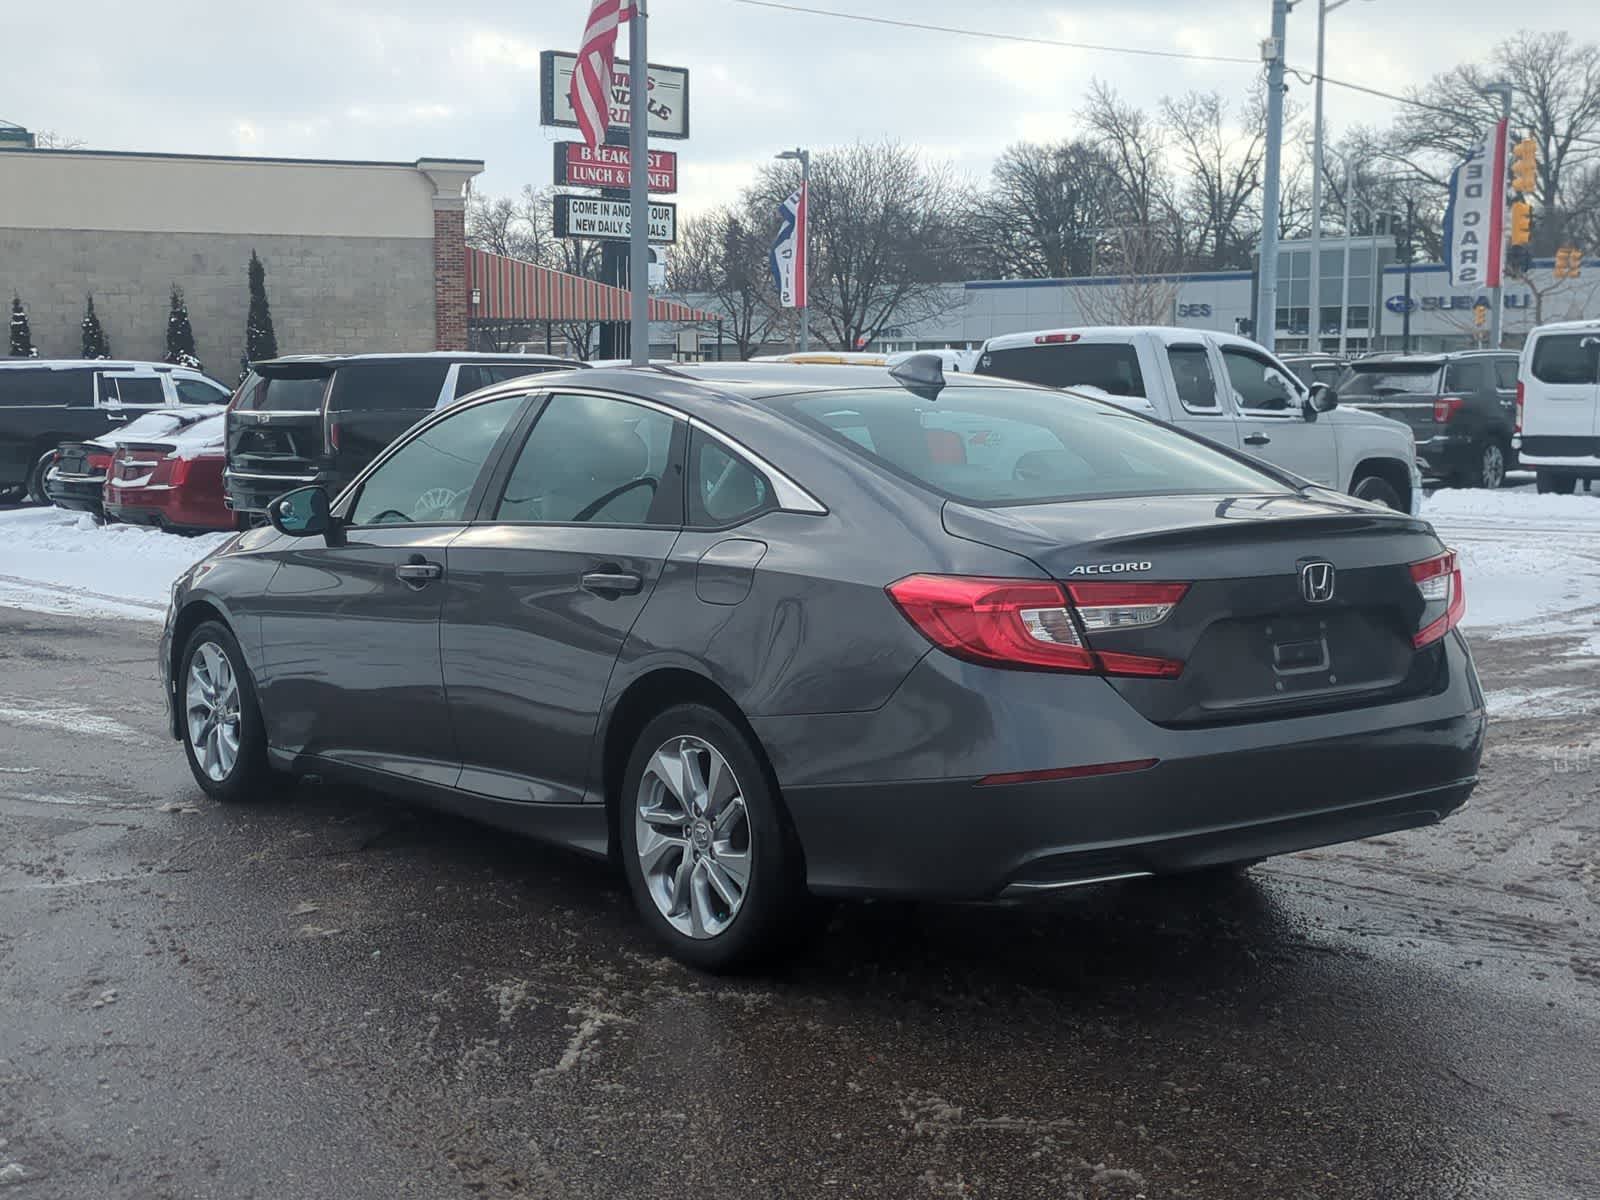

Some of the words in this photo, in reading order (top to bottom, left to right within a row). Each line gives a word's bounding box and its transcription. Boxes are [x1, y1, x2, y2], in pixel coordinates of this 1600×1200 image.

[581, 147, 663, 168] BEAKST
[573, 166, 612, 182] LUNCH
[616, 170, 625, 183] &
[629, 172, 670, 188] NER
[572, 201, 598, 215] COME
[601, 204, 610, 216] IN
[612, 204, 631, 217] AND
[651, 207, 670, 220] OUR
[576, 218, 596, 232] NEW
[598, 220, 623, 234] DAILY
[625, 223, 667, 237] SIALS
[1069, 560, 1153, 576] ACCORD
